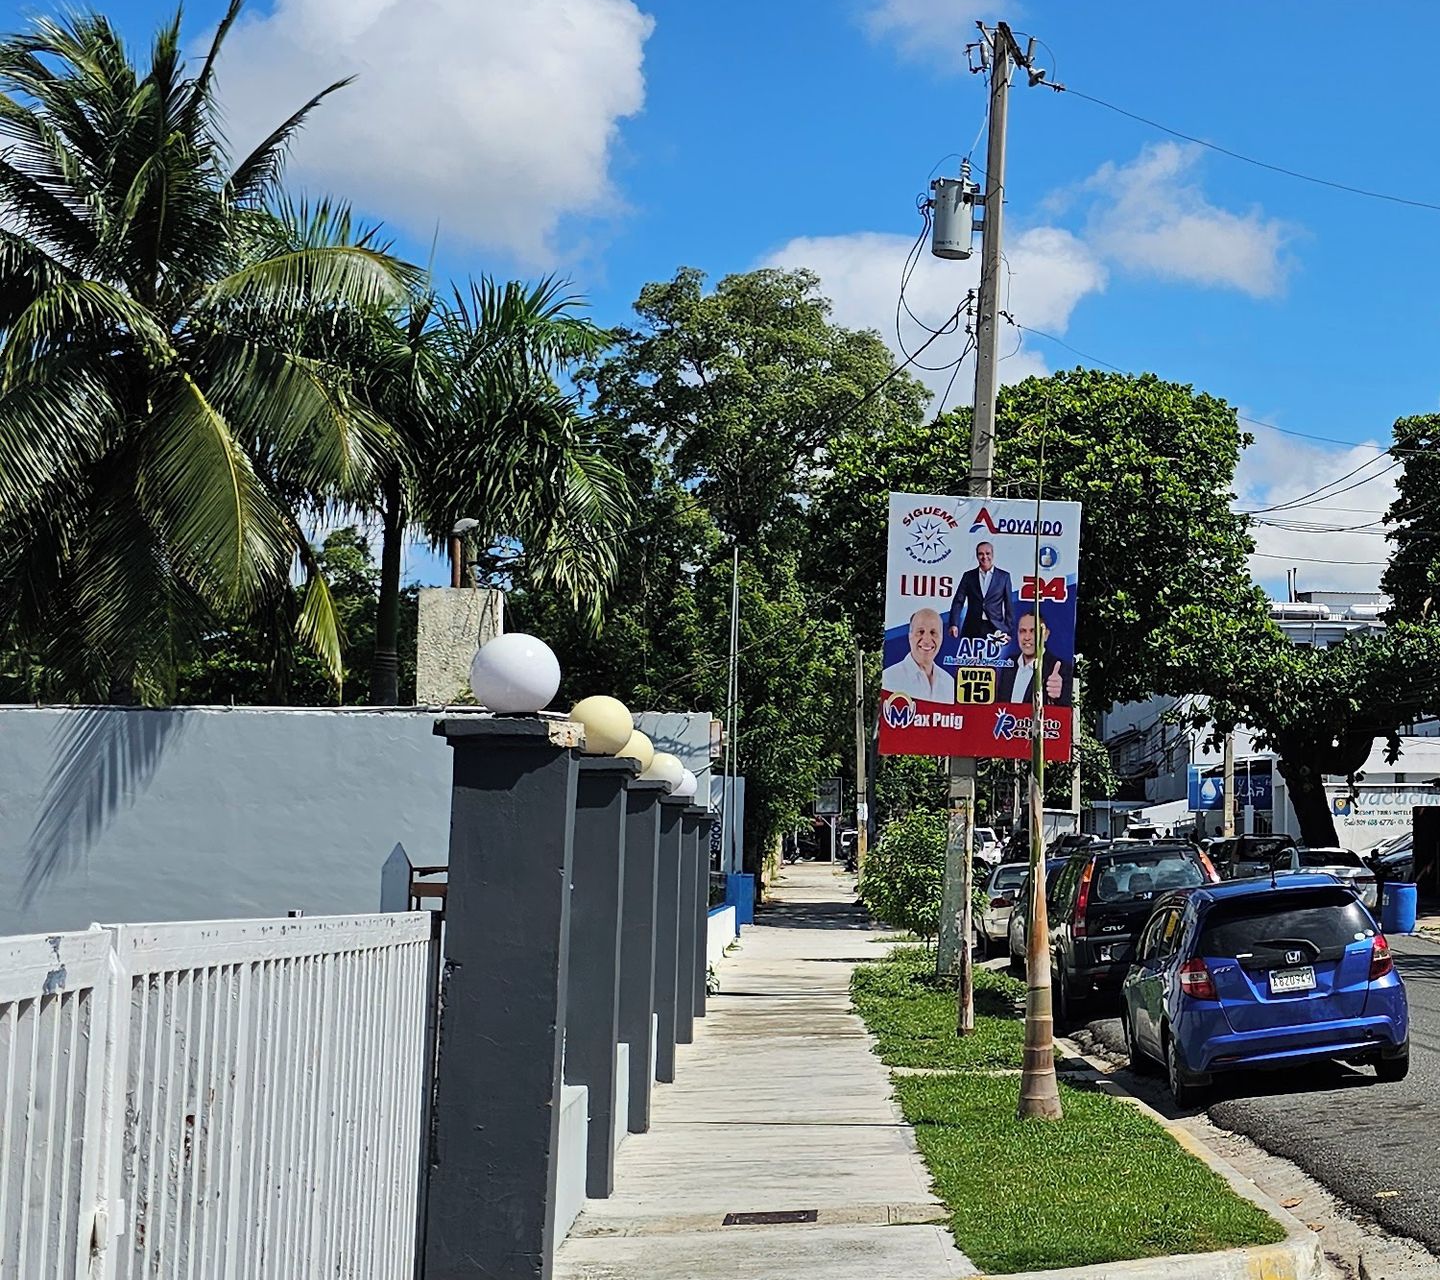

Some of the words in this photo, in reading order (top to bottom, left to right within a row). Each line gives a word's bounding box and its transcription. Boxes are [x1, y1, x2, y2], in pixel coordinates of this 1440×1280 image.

[902, 506, 959, 529] SIGUEME
[900, 574, 954, 598] LUIS
[1020, 575, 1068, 602] 24
[956, 637, 1002, 660] APD
[961, 670, 993, 681] VOTA
[960, 682, 991, 703] 15
[932, 712, 964, 730] Puig
